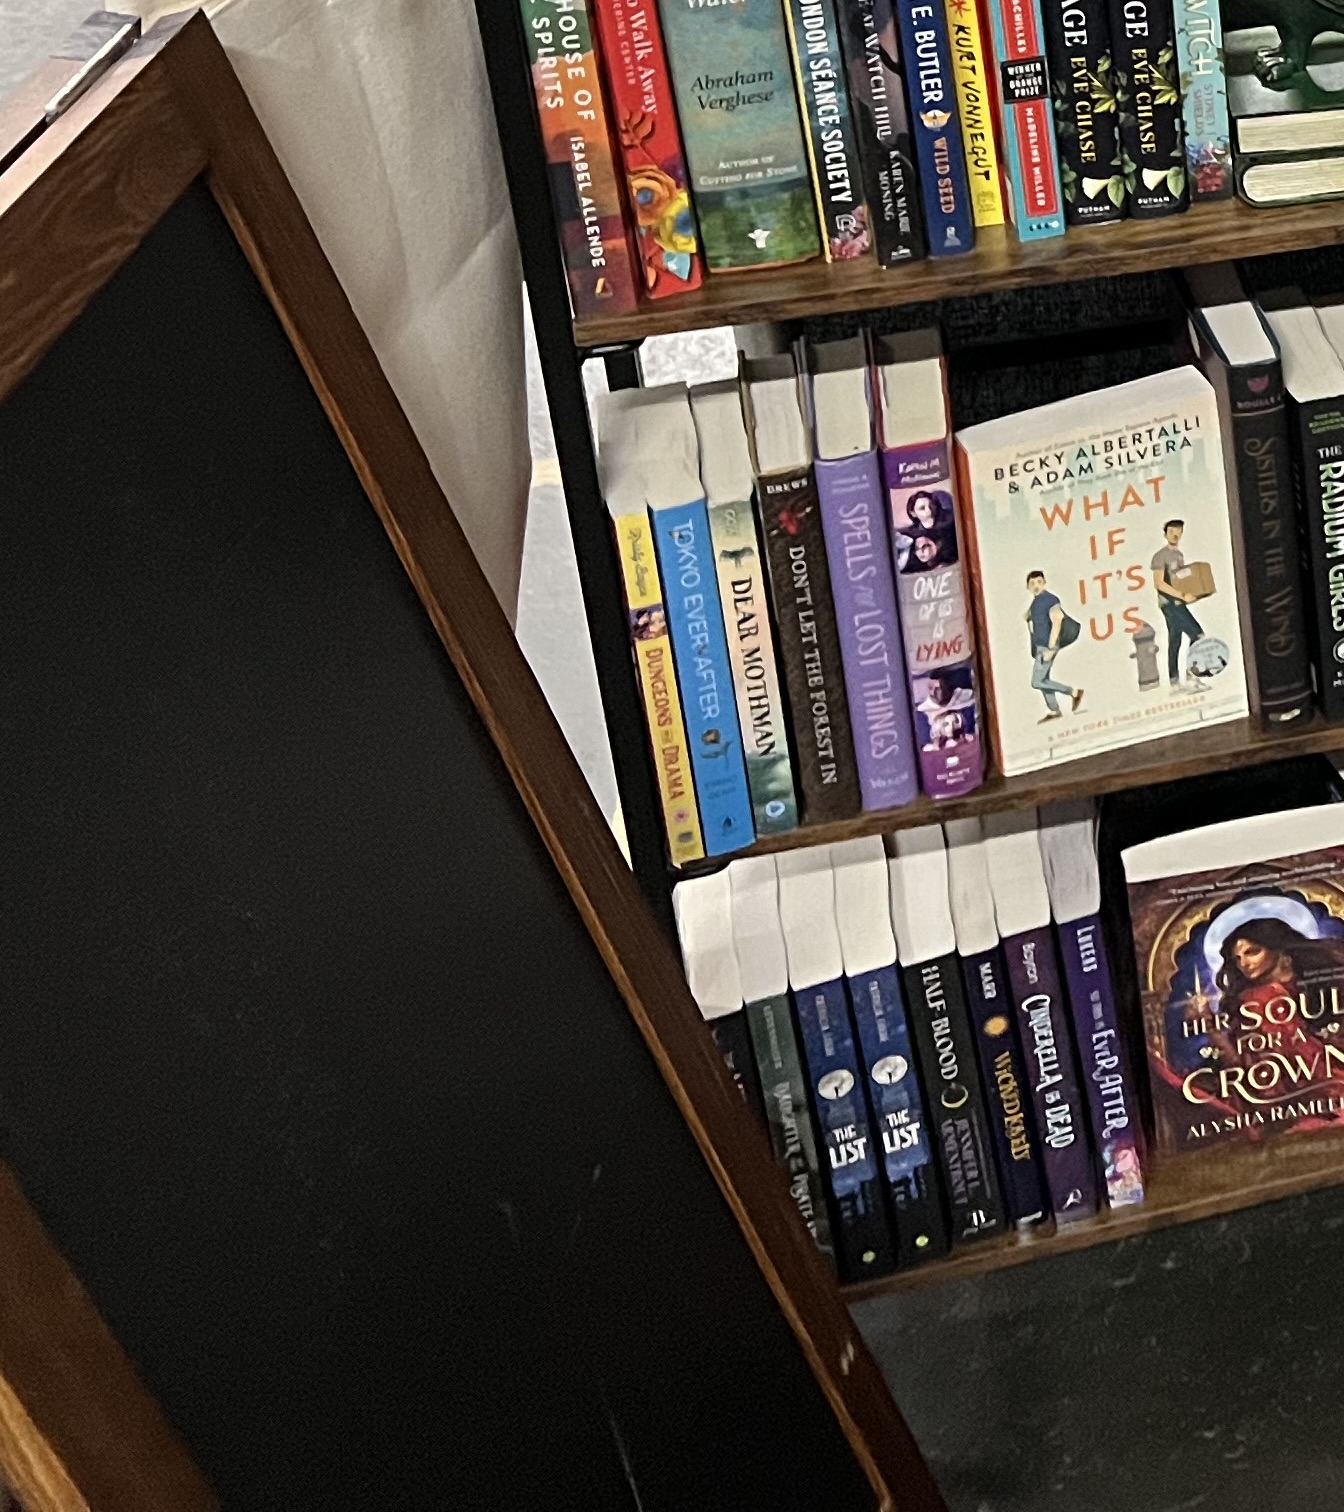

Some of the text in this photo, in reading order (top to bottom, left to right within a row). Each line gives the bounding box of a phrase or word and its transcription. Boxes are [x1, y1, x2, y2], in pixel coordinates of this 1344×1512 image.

[532, 16, 564, 110] SPIRITS
[691, 68, 775, 92] Abraham
[914, 30, 944, 104] BUTLER
[1069, 57, 1089, 89] EVE
[1131, 48, 1149, 81] EVE
[697, 89, 775, 112] Verghese
[1134, 83, 1157, 156] CHASE
[1074, 94, 1097, 164] CHASE
[570, 135, 606, 269] ISABEL ALLENDE
[994, 415, 1201, 481] BECKY ALBERTALLI
[1008, 437, 1194, 494] & ADAM SILVERA
[1039, 475, 1167, 532] WHAT
[1088, 527, 1126, 561] IF
[1078, 563, 1147, 605] IT'S
[1088, 606, 1144, 641] US
[730, 575, 777, 757] DEAR MOTHMAN
[1182, 1013, 1231, 1039] HER
[882, 1122, 921, 1154] LIST
